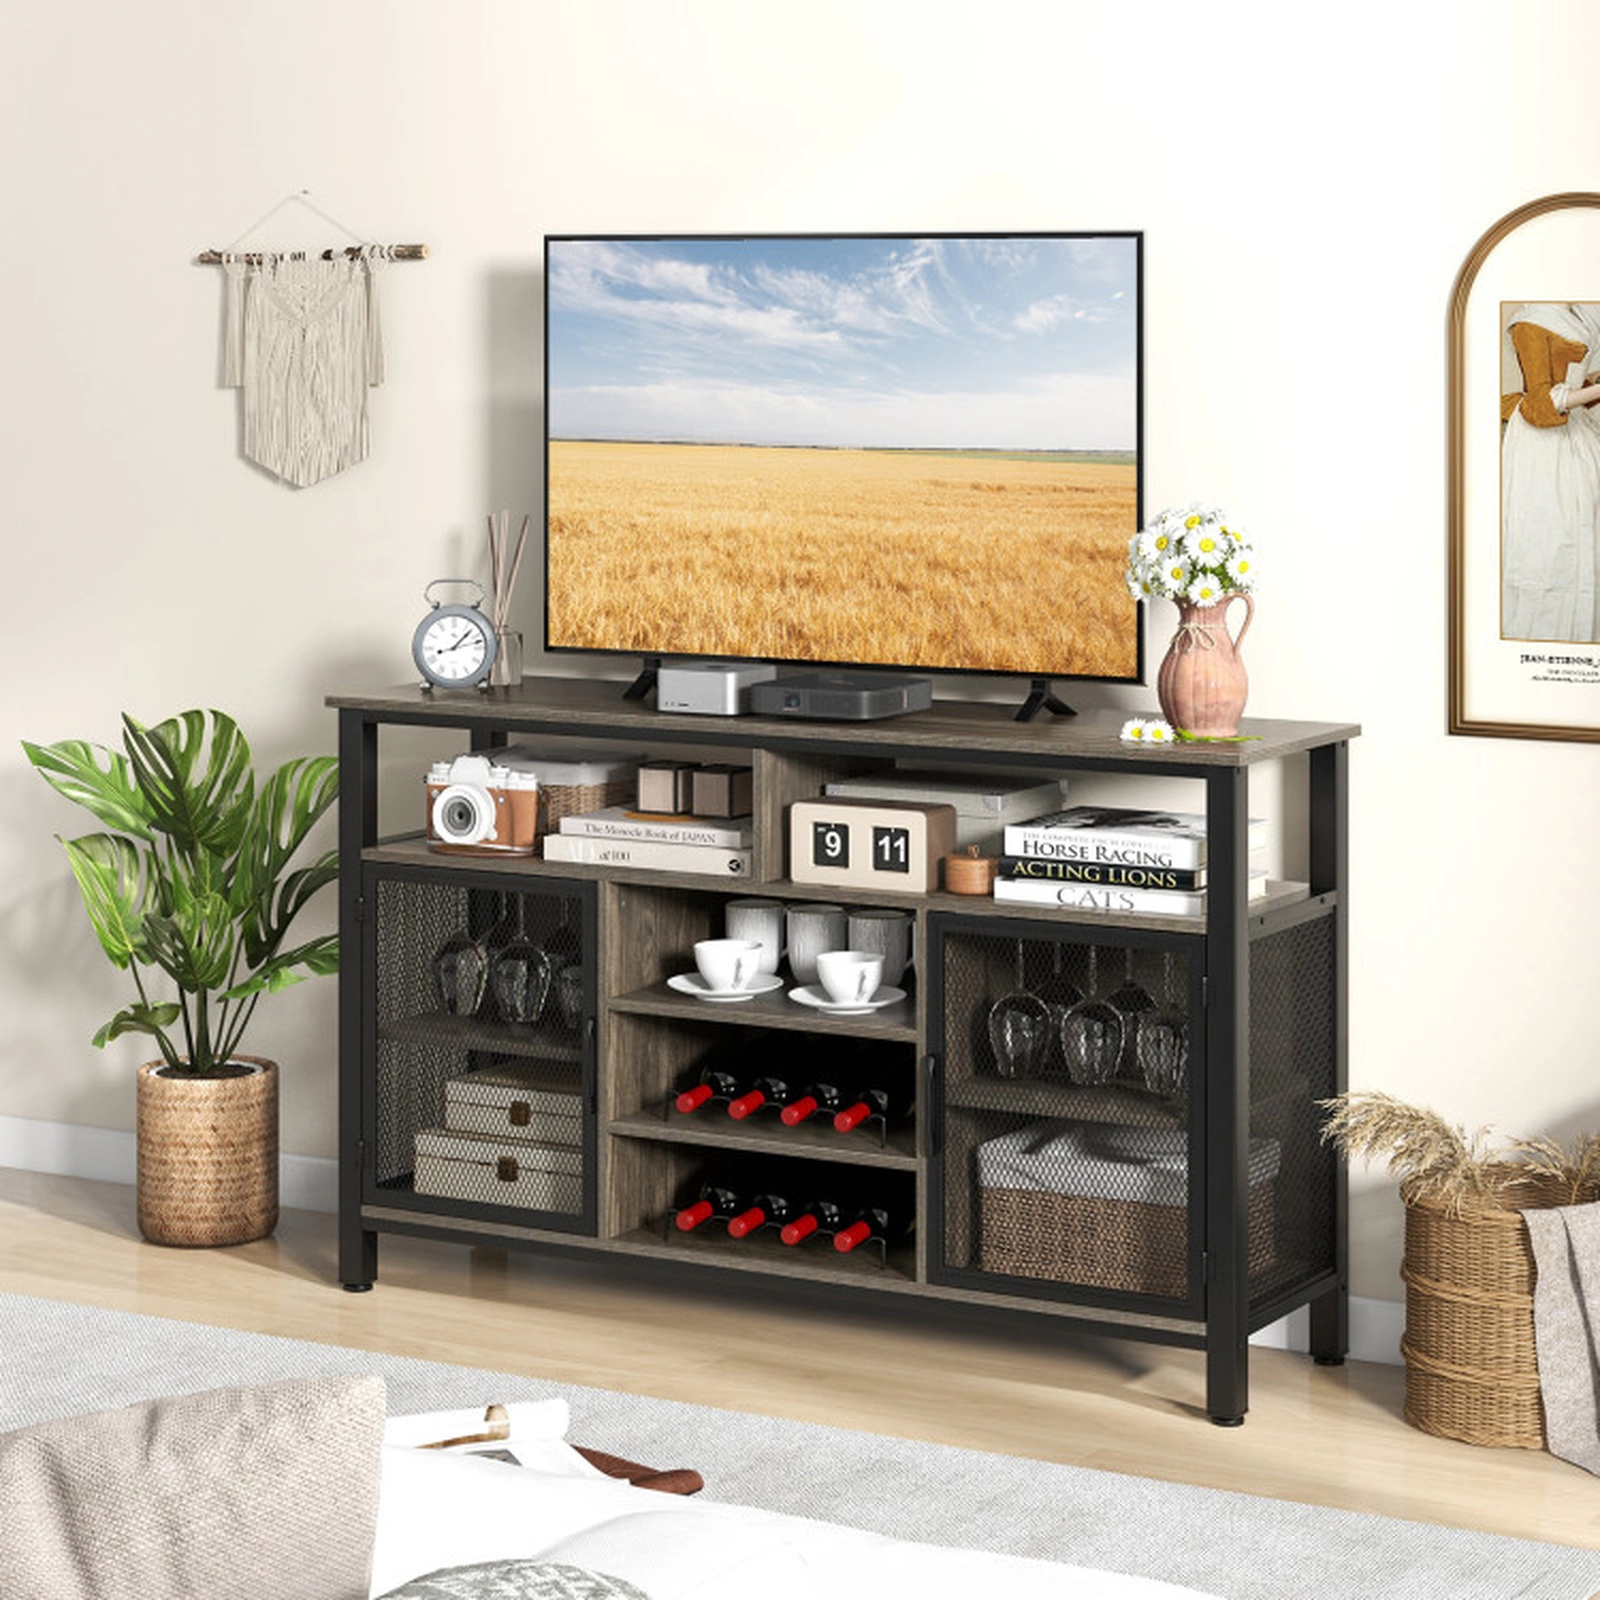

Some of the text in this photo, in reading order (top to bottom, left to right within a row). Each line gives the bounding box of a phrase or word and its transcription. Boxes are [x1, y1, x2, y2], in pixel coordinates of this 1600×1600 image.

[584, 823, 602, 834] The
[644, 828, 669, 840] Book
[669, 831, 681, 841] of
[681, 832, 716, 844] JAPAN
[825, 831, 906, 863] 9 11
[1023, 839, 1089, 860] HORSE
[1095, 845, 1173, 868] RACING
[1012, 861, 1177, 888] ACTING LIONS
[1056, 886, 1136, 911] CATS
